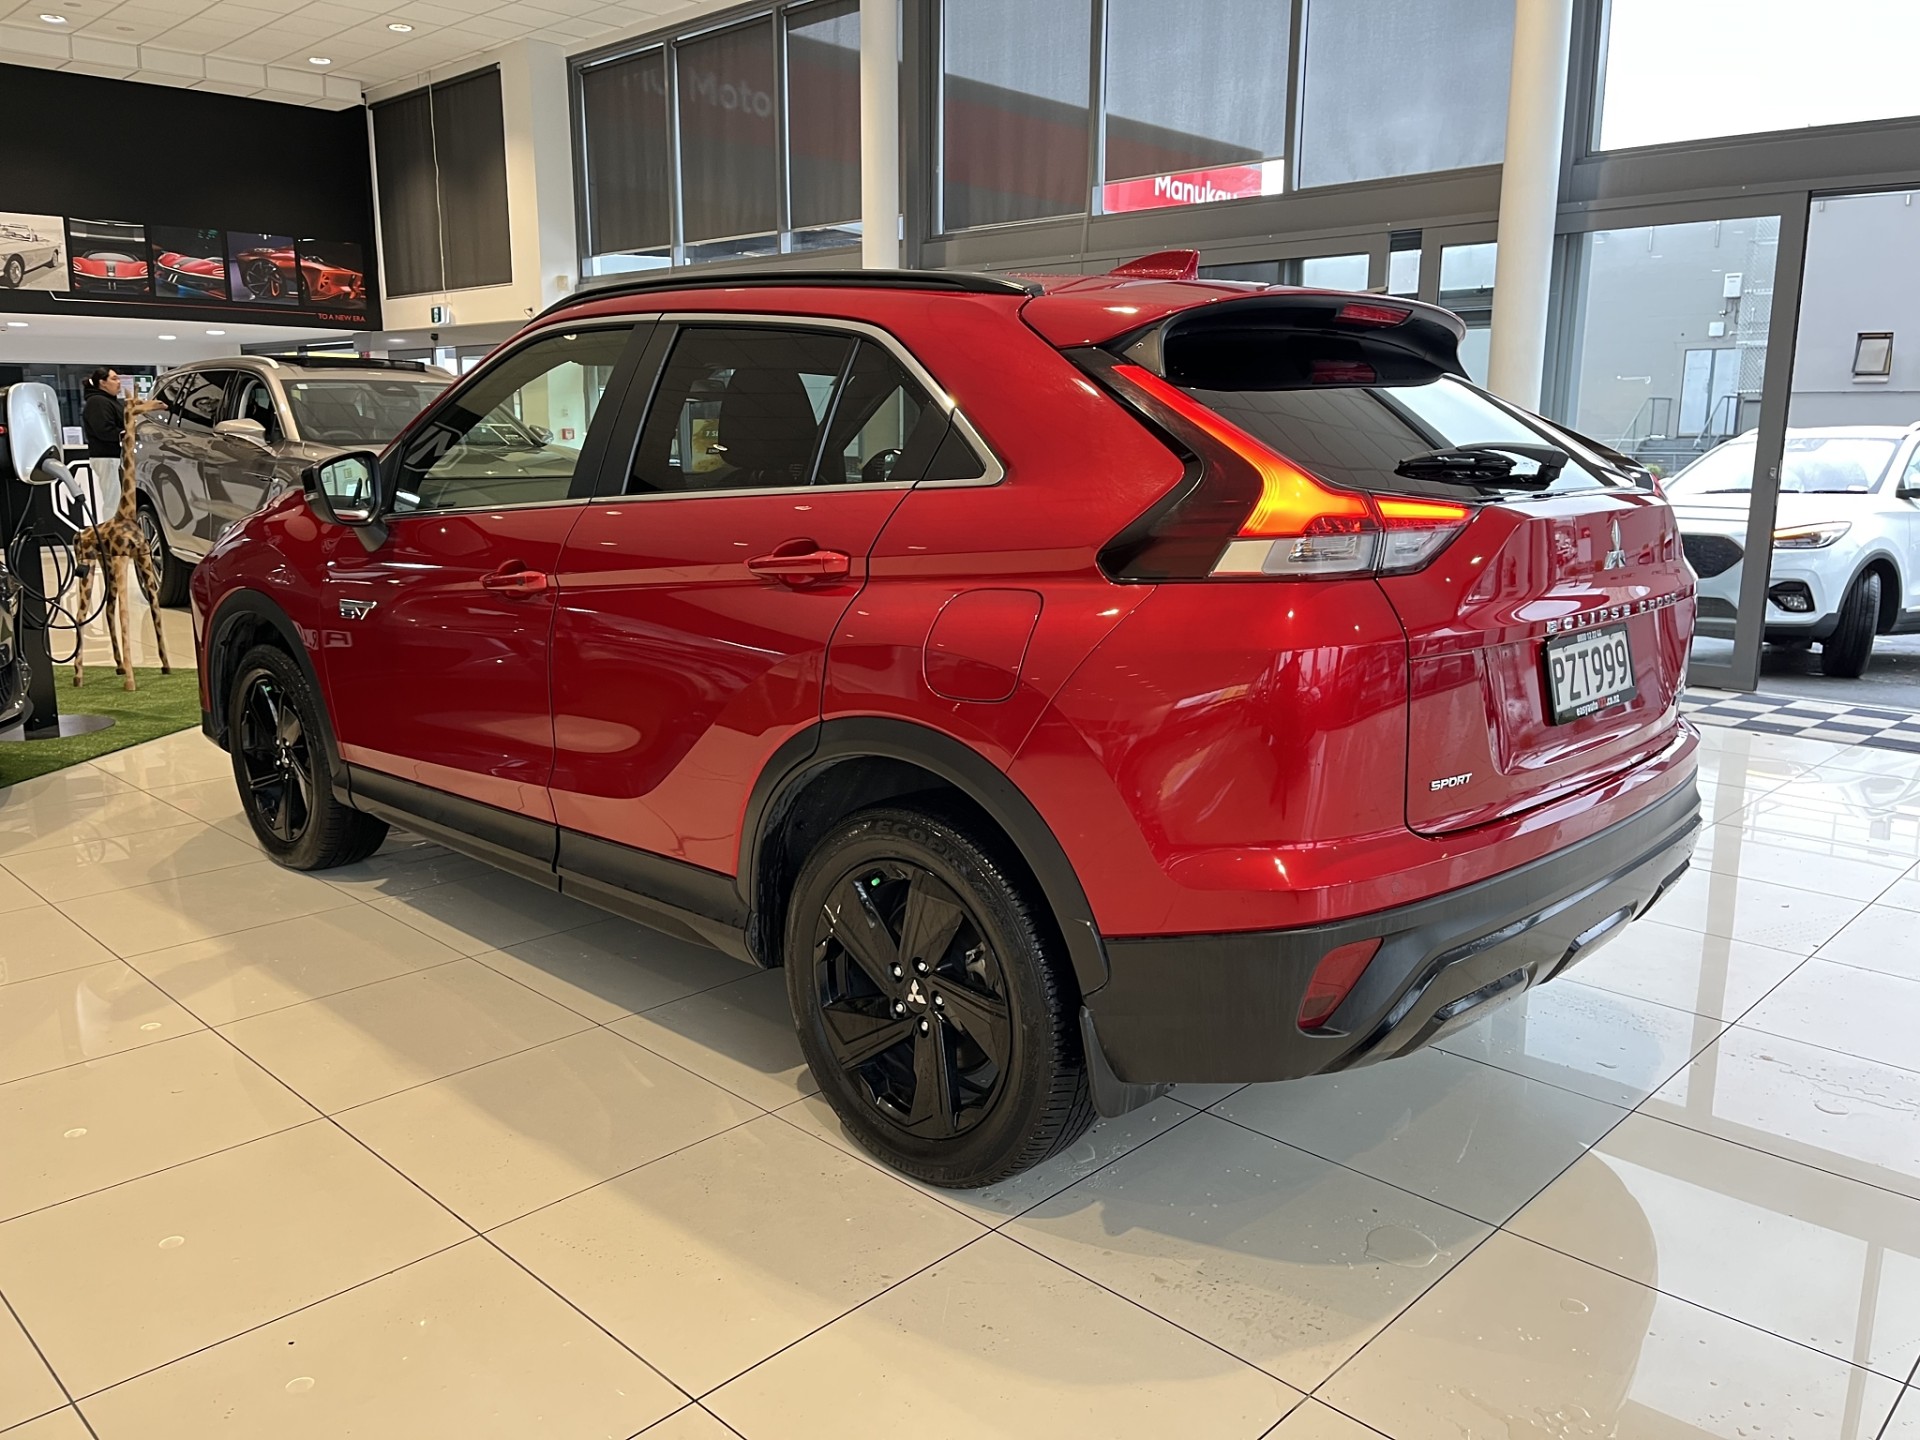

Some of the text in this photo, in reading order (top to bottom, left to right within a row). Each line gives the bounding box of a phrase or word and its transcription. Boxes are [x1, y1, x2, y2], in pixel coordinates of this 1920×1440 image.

[1547, 593, 1677, 634] ECLIPSE CROSS
[1551, 639, 1628, 706] PZT999
[1429, 771, 1473, 791] SPORT
